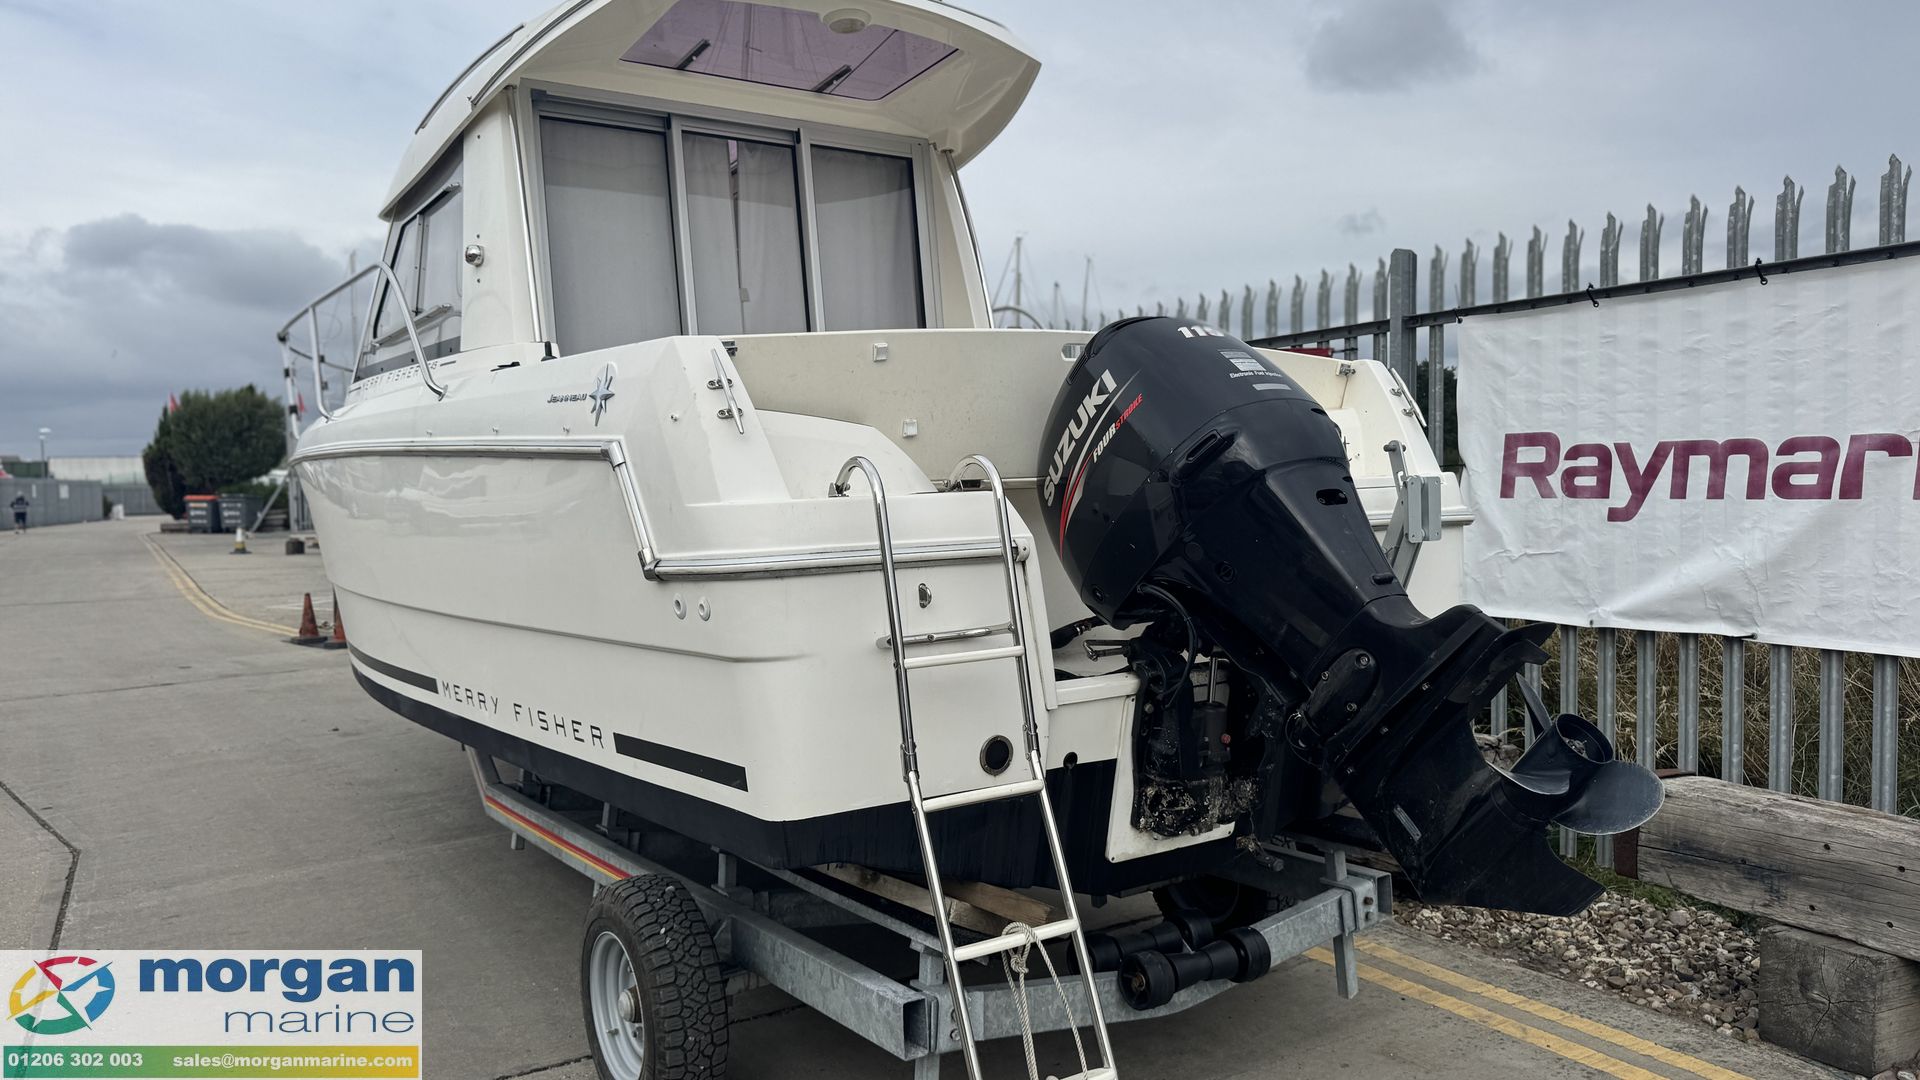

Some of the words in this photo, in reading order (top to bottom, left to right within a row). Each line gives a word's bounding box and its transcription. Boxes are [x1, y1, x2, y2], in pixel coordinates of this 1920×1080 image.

[1044, 368, 1117, 507] SUZUKI
[442, 680, 499, 714] MERRY
[513, 703, 604, 749] FISHER
